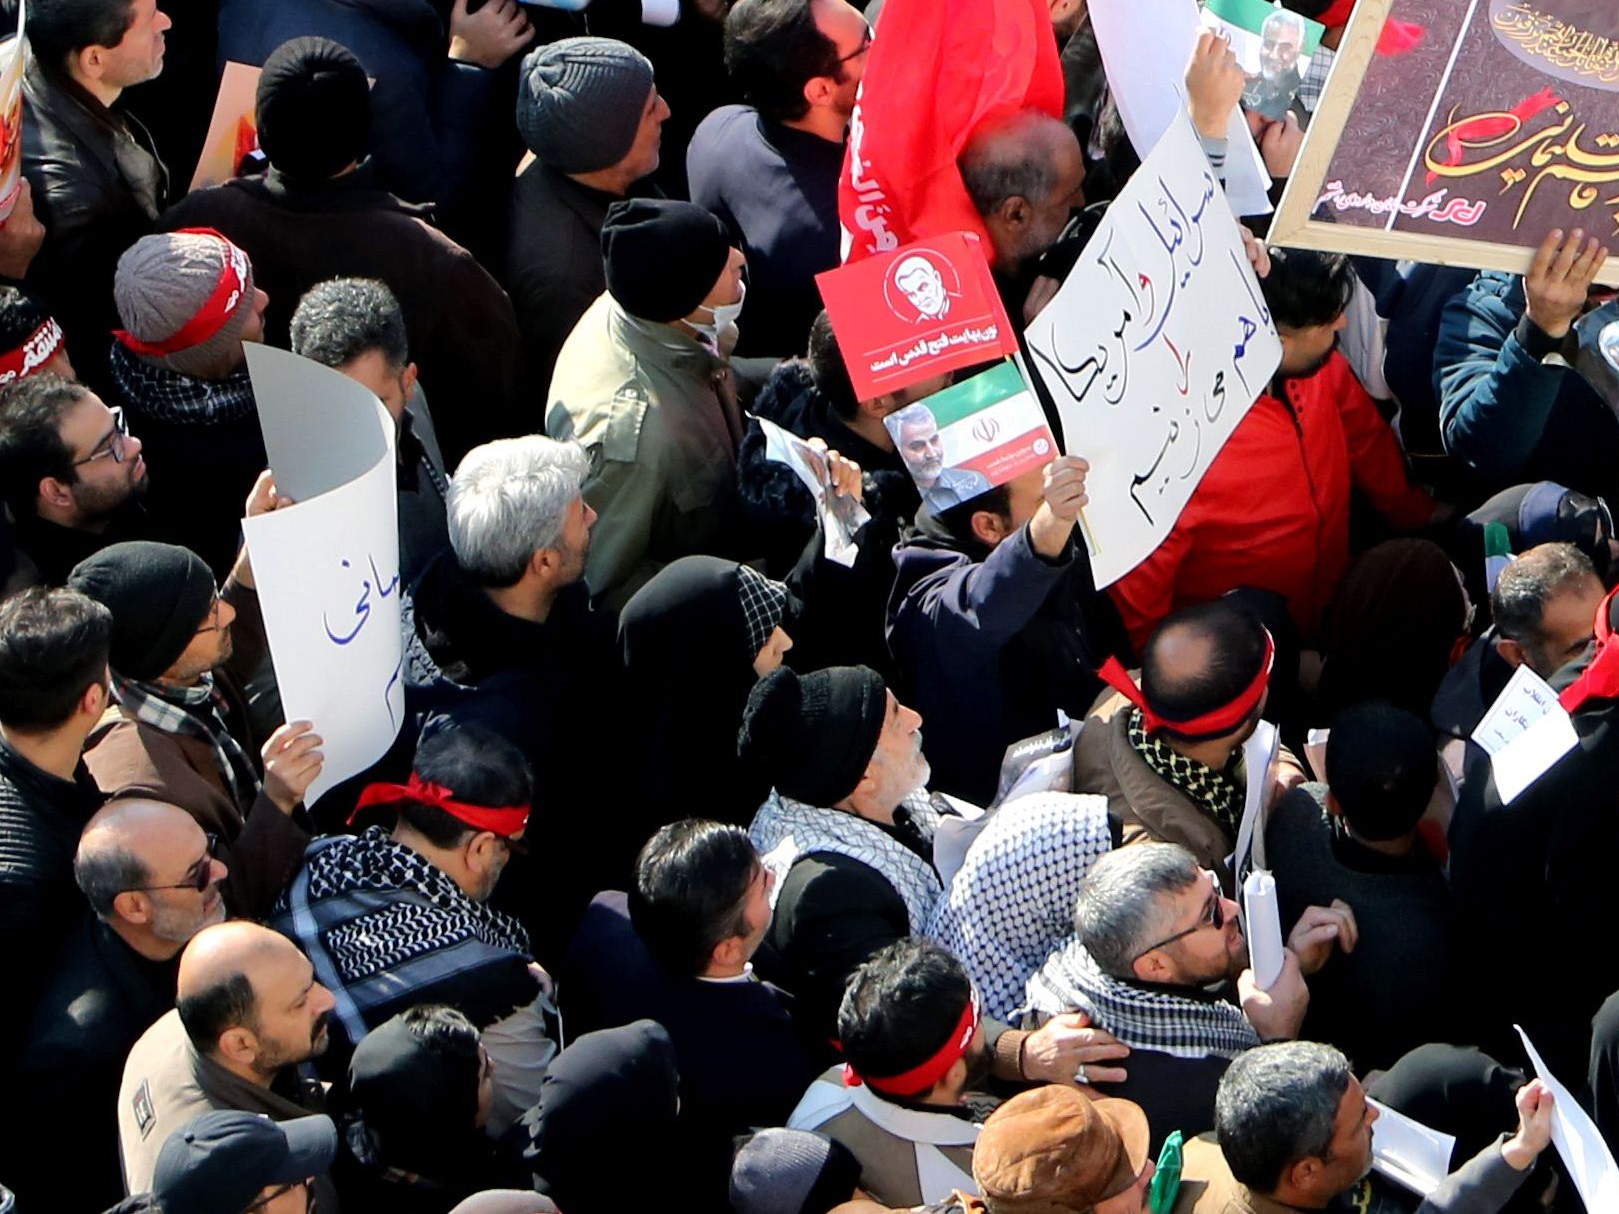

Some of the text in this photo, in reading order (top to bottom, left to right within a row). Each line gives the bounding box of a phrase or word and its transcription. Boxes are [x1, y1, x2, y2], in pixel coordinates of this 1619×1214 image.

[1028, 226, 1143, 405] آمریکا
[1134, 173, 1216, 352] سرائیل
[1162, 332, 1191, 396] را
